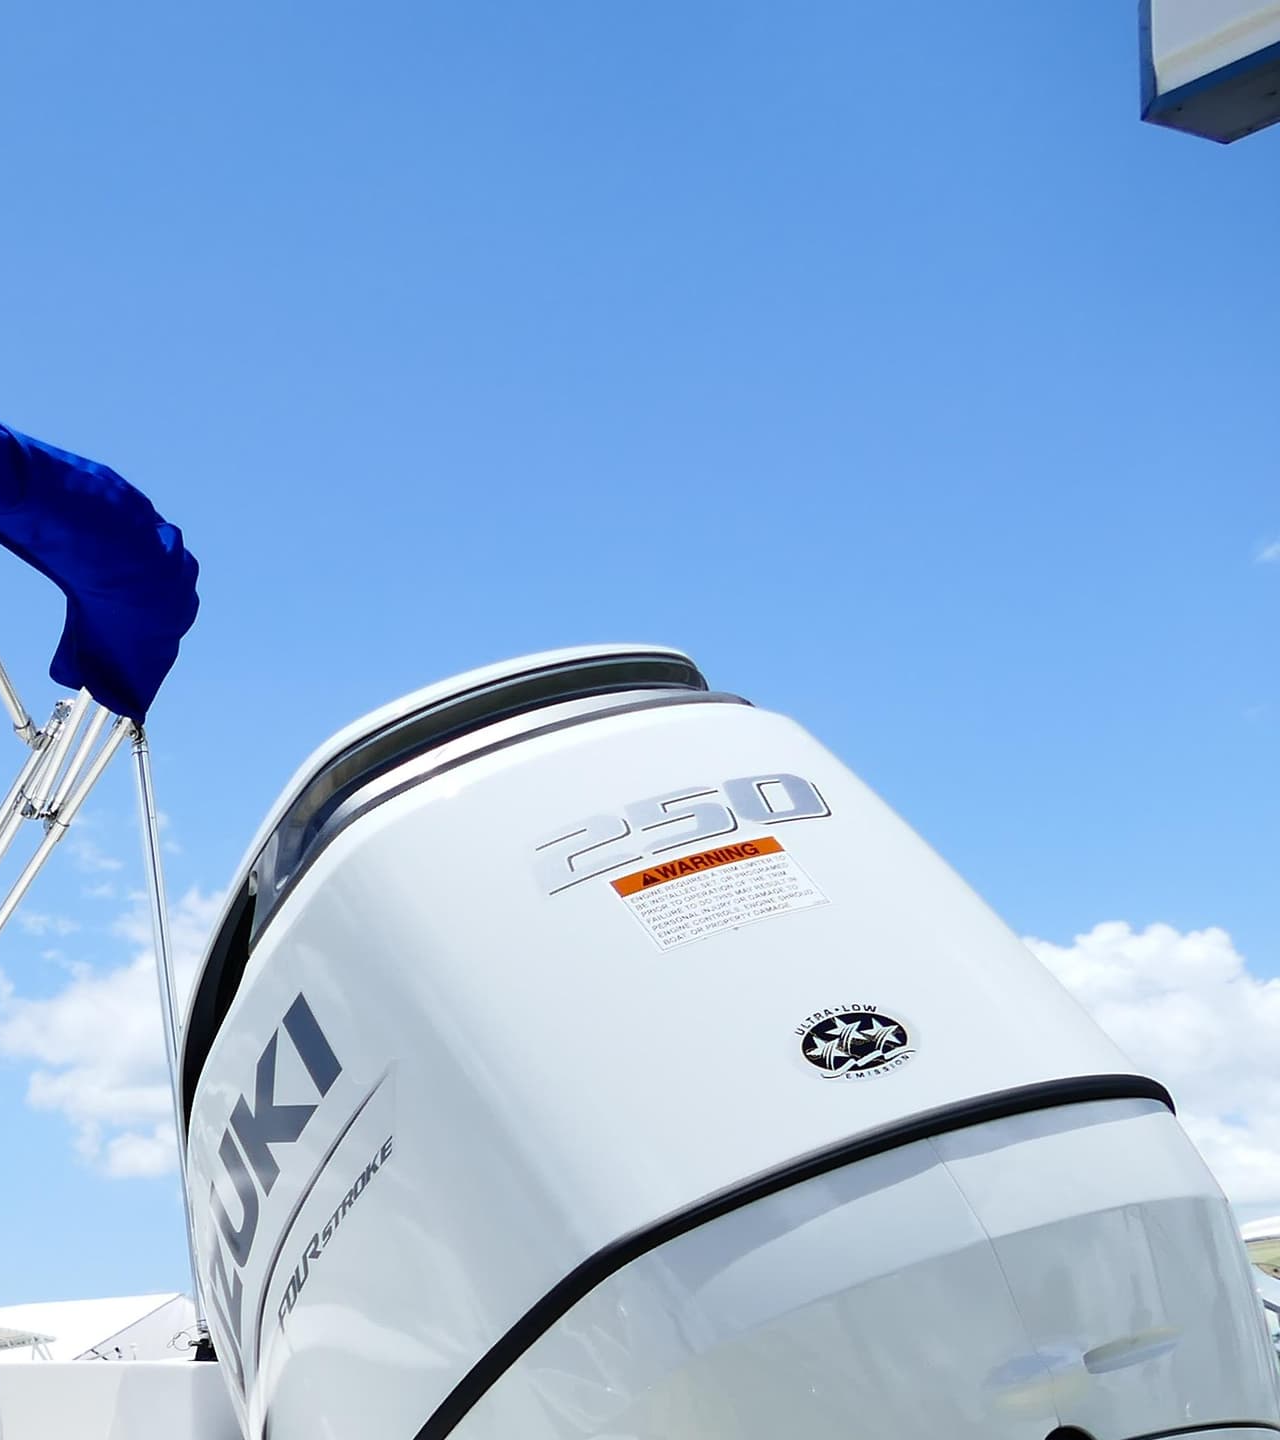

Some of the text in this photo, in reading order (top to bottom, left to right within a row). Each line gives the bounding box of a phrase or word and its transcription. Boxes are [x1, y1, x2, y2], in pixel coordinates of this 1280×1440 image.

[534, 773, 832, 895] 250
[655, 843, 760, 880] WARNING
[670, 900, 682, 909] TO
[845, 1055, 910, 1079] EMISSION
